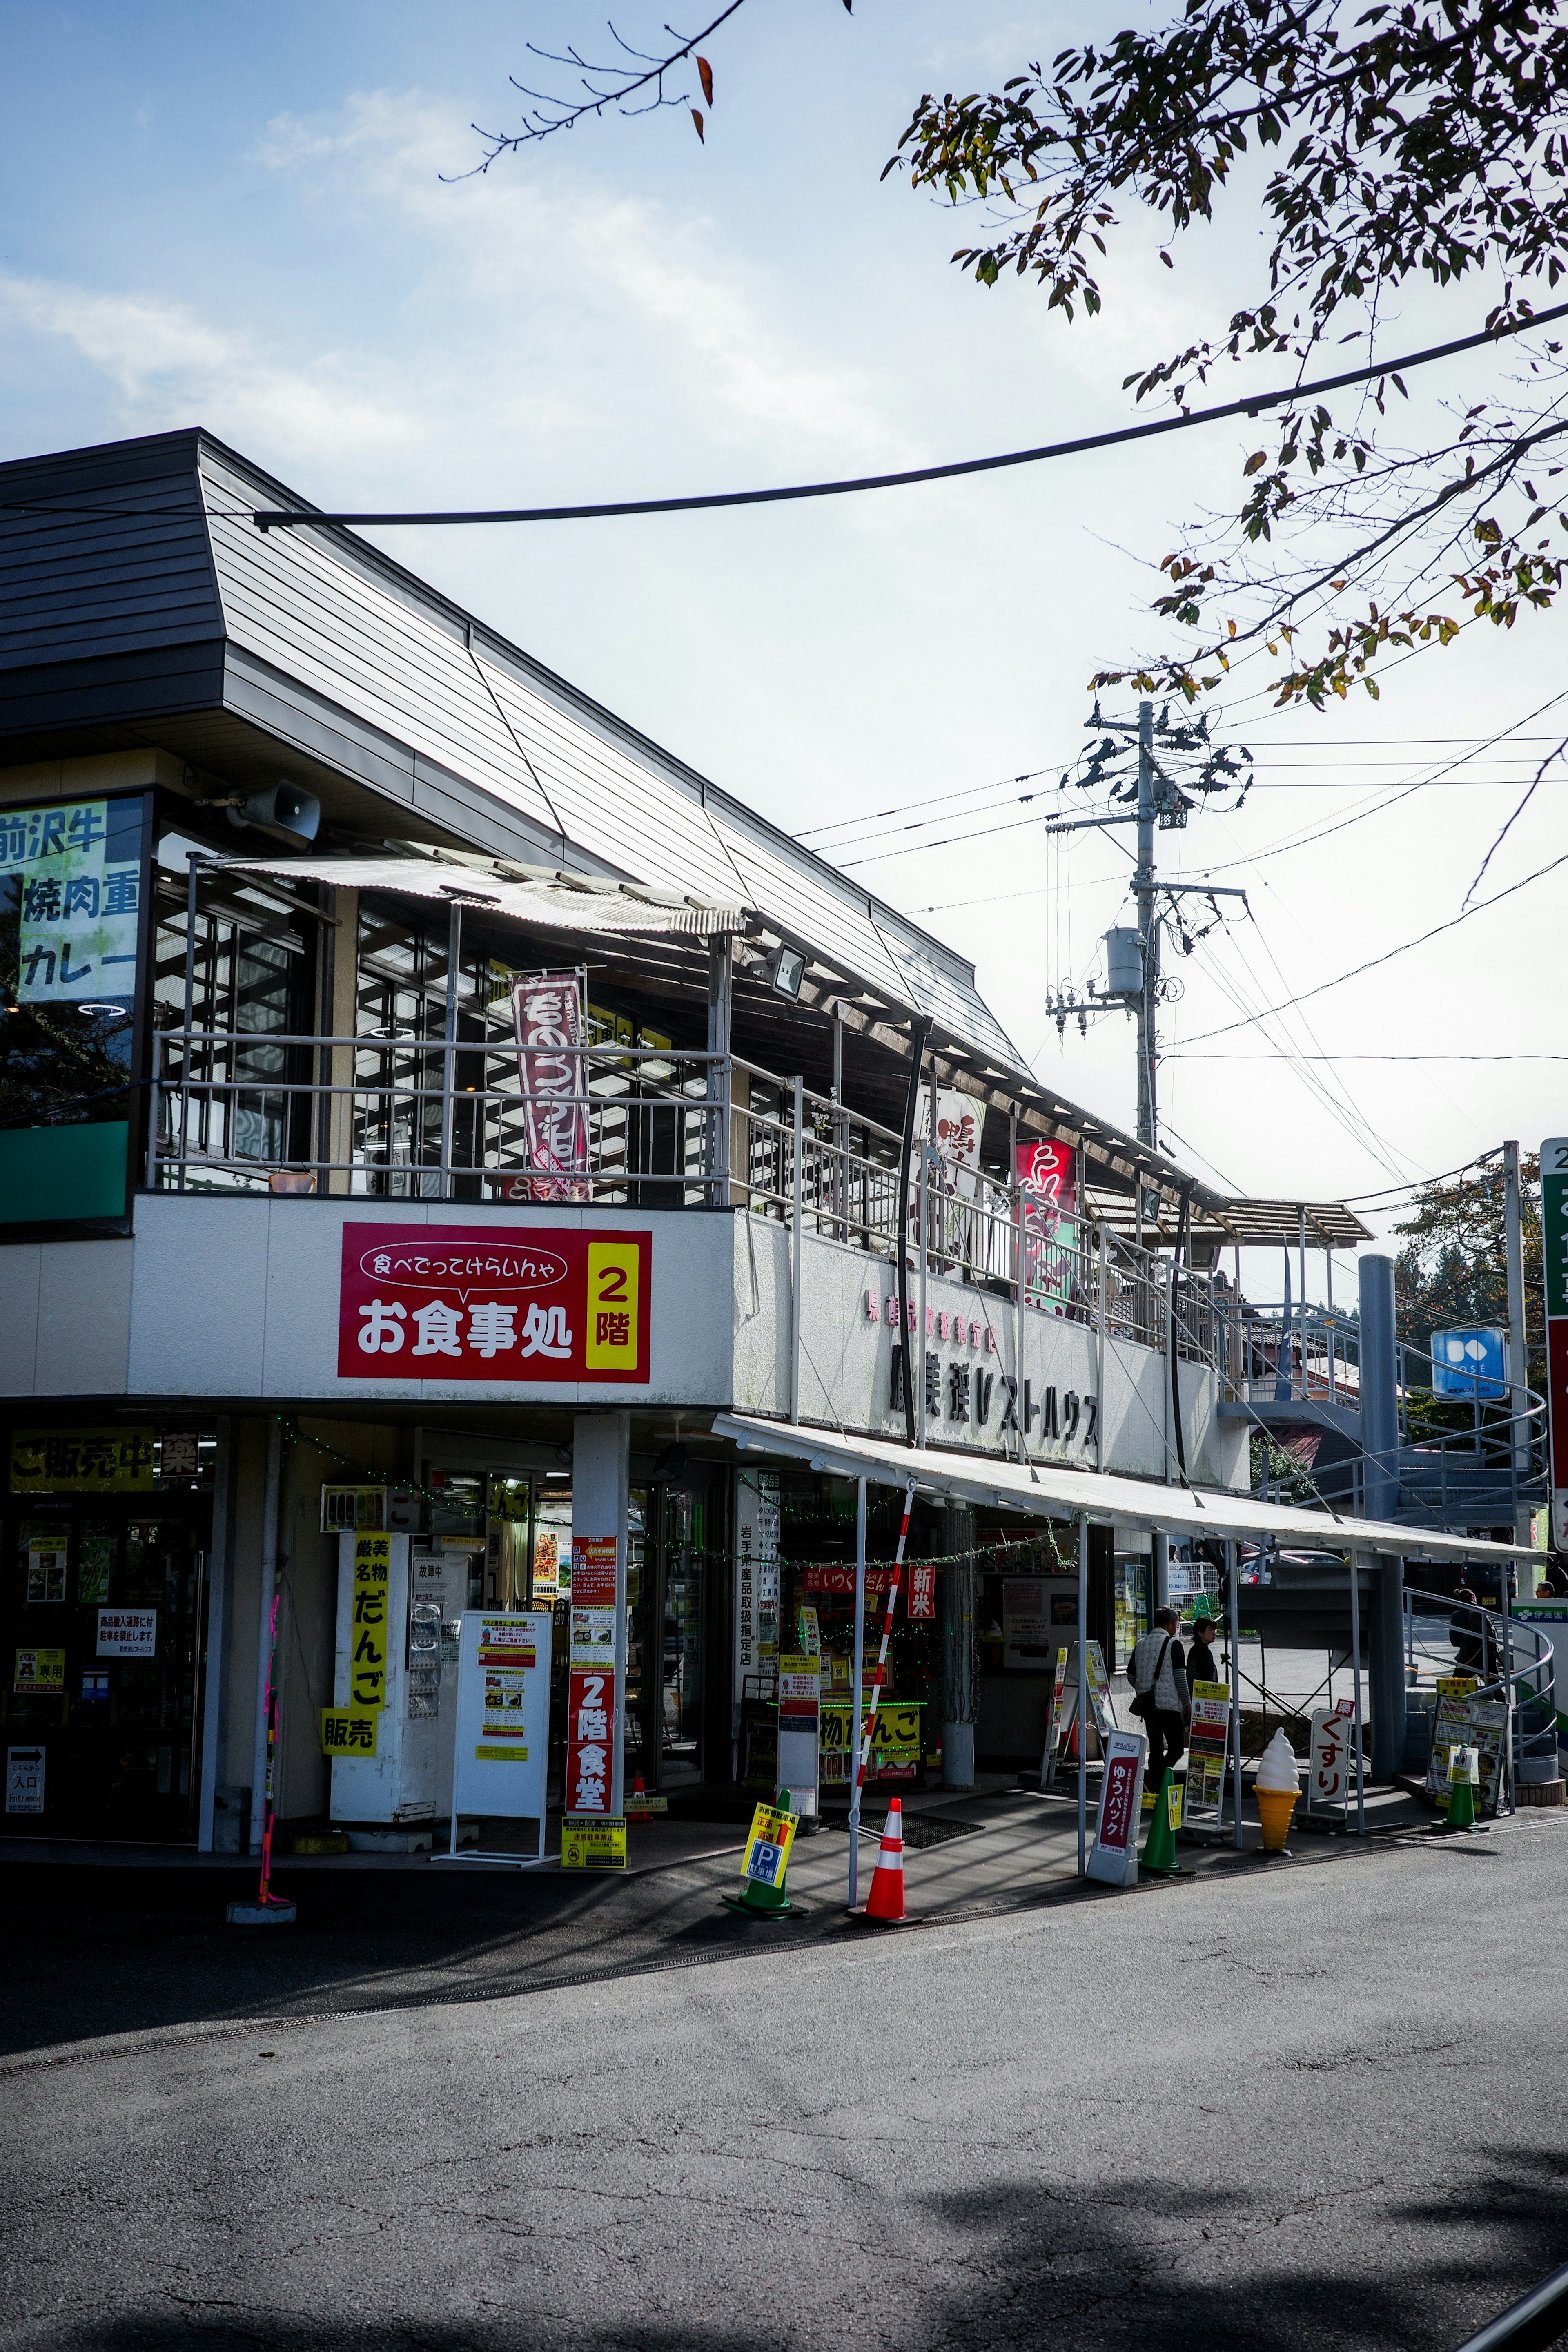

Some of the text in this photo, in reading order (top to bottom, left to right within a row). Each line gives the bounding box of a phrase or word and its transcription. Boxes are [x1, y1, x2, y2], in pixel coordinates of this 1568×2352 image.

[0, 807, 105, 861] 前沢牛
[23, 869, 139, 922] 焼肉重
[22, 943, 136, 985] カレー
[358, 1299, 572, 1358] お食事処
[759, 1474, 779, 1487] 取扱品目
[356, 1539, 388, 1558] 厳美
[356, 1563, 388, 1582] 名物
[419, 1564, 442, 1578] 故障中
[739, 1525, 752, 1666] 岩手県産品取扱指定店
[914, 1568, 931, 1616] 新米
[100, 1616, 153, 1627] 商品搬入通路に付
[1534, 1610, 1563, 1619] 伊藤園
[100, 1631, 153, 1642] 駐車を禁止します。
[353, 1590, 385, 1704] だんご
[40, 1665, 62, 1678] 専用
[325, 1718, 373, 1748] 販売
[575, 1676, 607, 1810] 2階食堂
[1317, 1717, 1344, 1796] くすり
[14, 1776, 37, 1789] 入口
[10, 1794, 41, 1802] Entrance
[1106, 1766, 1126, 1836] ゆうパック
[757, 1816, 773, 1830] 正面
[758, 1806, 796, 1825] お客様駐車場
[757, 1830, 775, 1844] 直進
[757, 1846, 774, 1866] P
[750, 1863, 773, 1880] 駐車場
